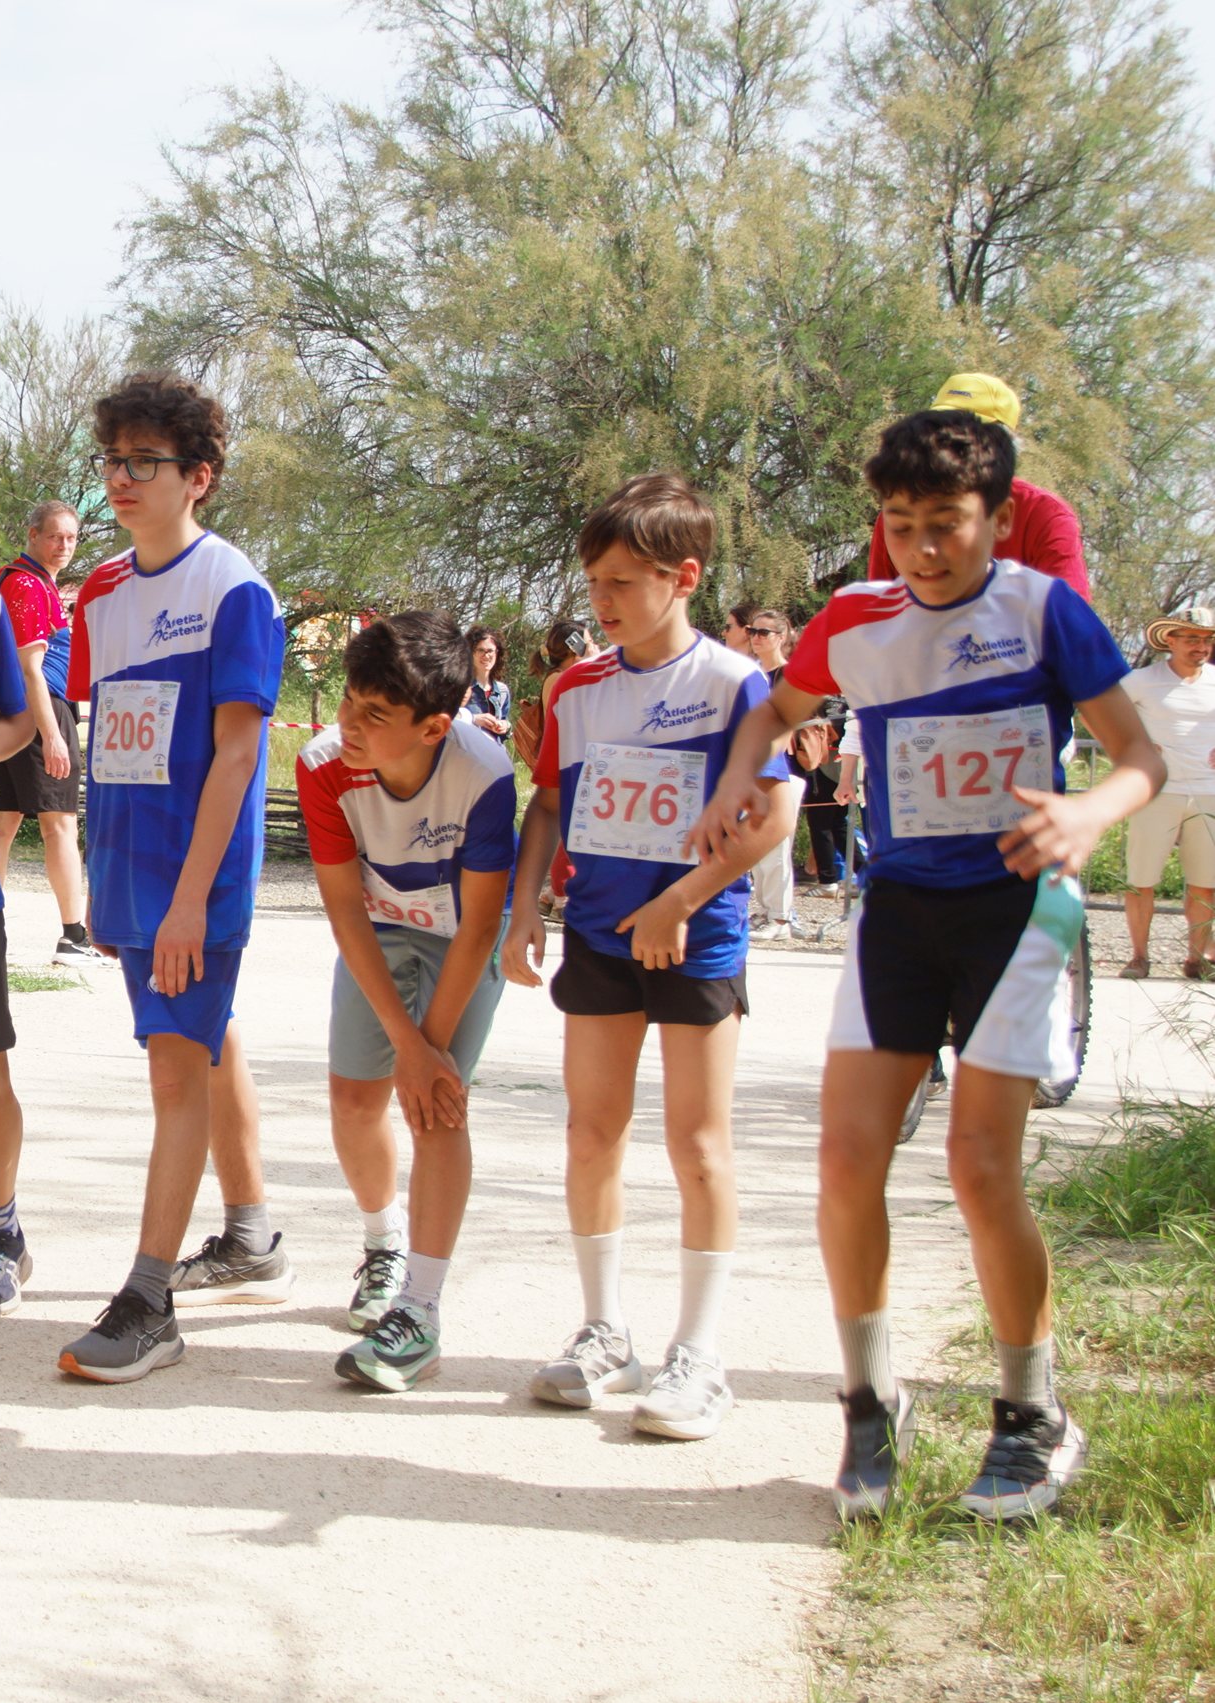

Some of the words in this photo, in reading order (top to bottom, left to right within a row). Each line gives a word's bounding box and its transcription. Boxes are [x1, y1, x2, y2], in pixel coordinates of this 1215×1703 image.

[974, 637, 1022, 653] Atletica
[660, 707, 718, 728] Castenaso
[663, 700, 707, 719] Atletica
[104, 711, 156, 752] 206
[922, 746, 1025, 798] 127
[592, 777, 679, 826] 376
